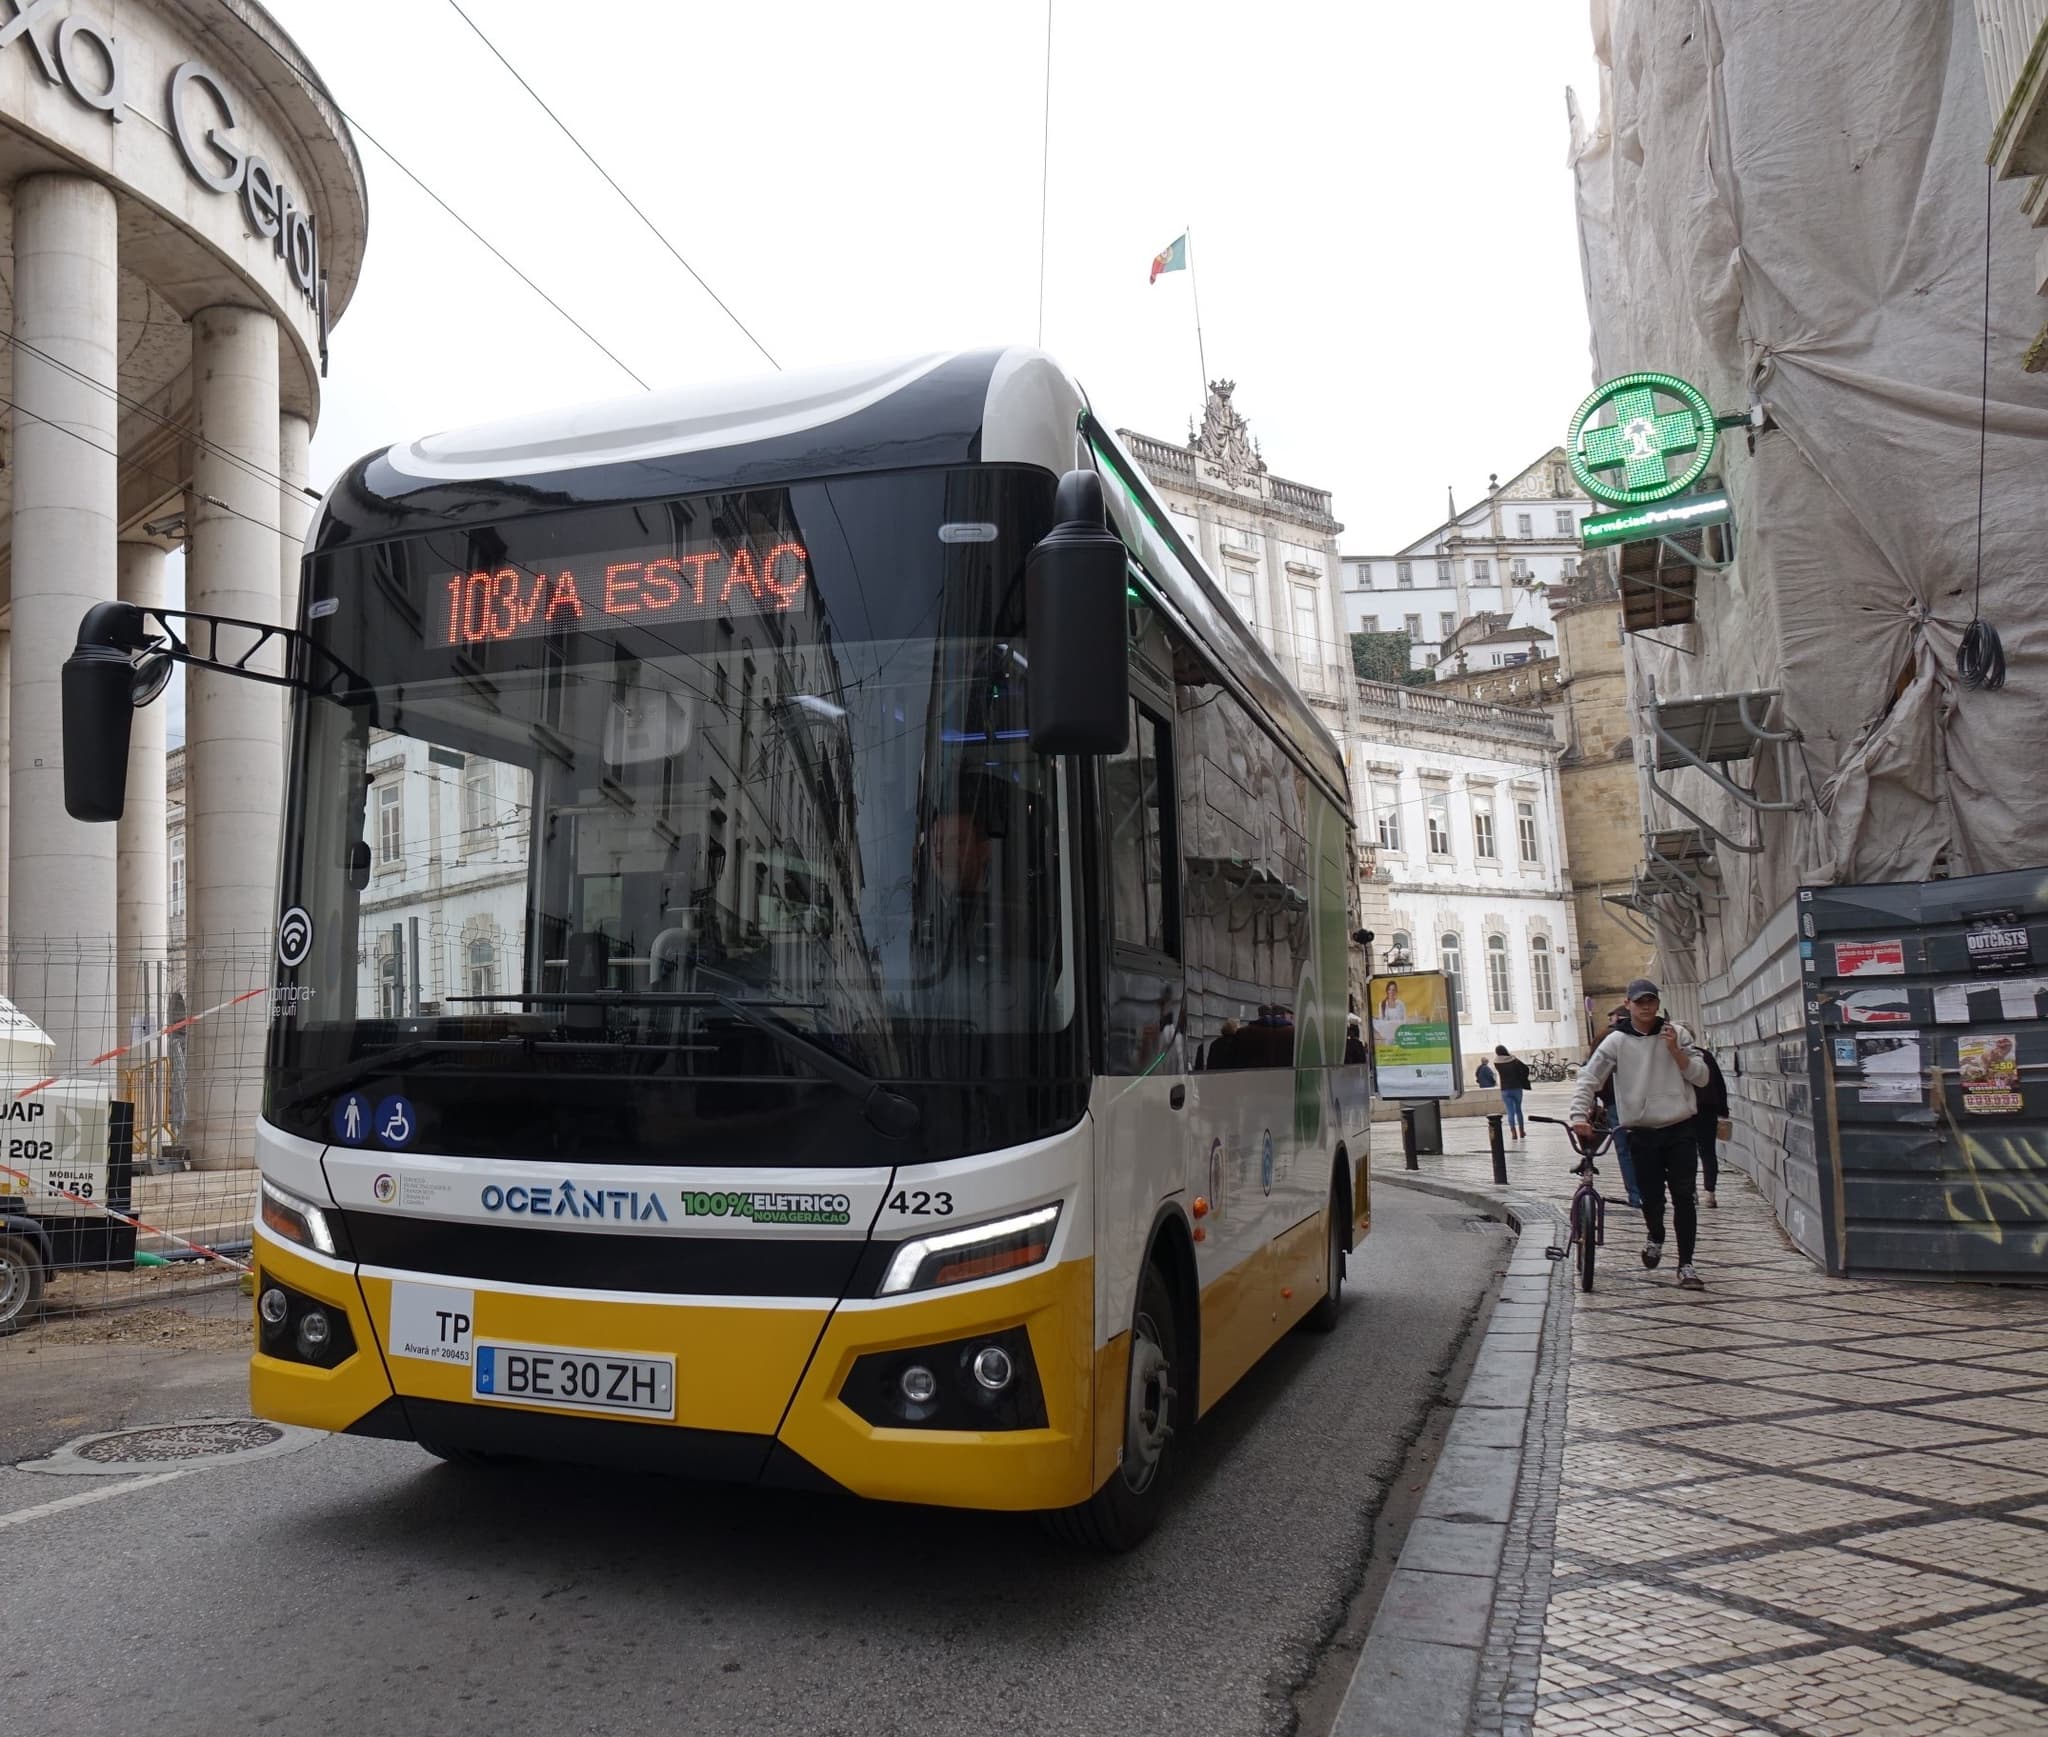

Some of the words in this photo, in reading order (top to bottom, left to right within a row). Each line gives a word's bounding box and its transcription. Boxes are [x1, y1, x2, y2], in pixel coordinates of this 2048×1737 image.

[169, 60, 320, 310] Geral
[448, 568, 520, 645] 103
[605, 543, 808, 613] ESTAÇ
[1968, 931, 2027, 950] OUTCASTS
[269, 981, 317, 1001] oimbra+
[10, 1139, 53, 1161] 202
[49, 1170, 95, 1180] MOBILAIR
[681, 1191, 754, 1217] 100%
[888, 1190, 955, 1216] 423
[436, 1311, 470, 1344] TP
[441, 1348, 470, 1361] 200453
[507, 1355, 554, 1395] BE
[560, 1360, 600, 1399] 30
[606, 1364, 656, 1404] ZH
